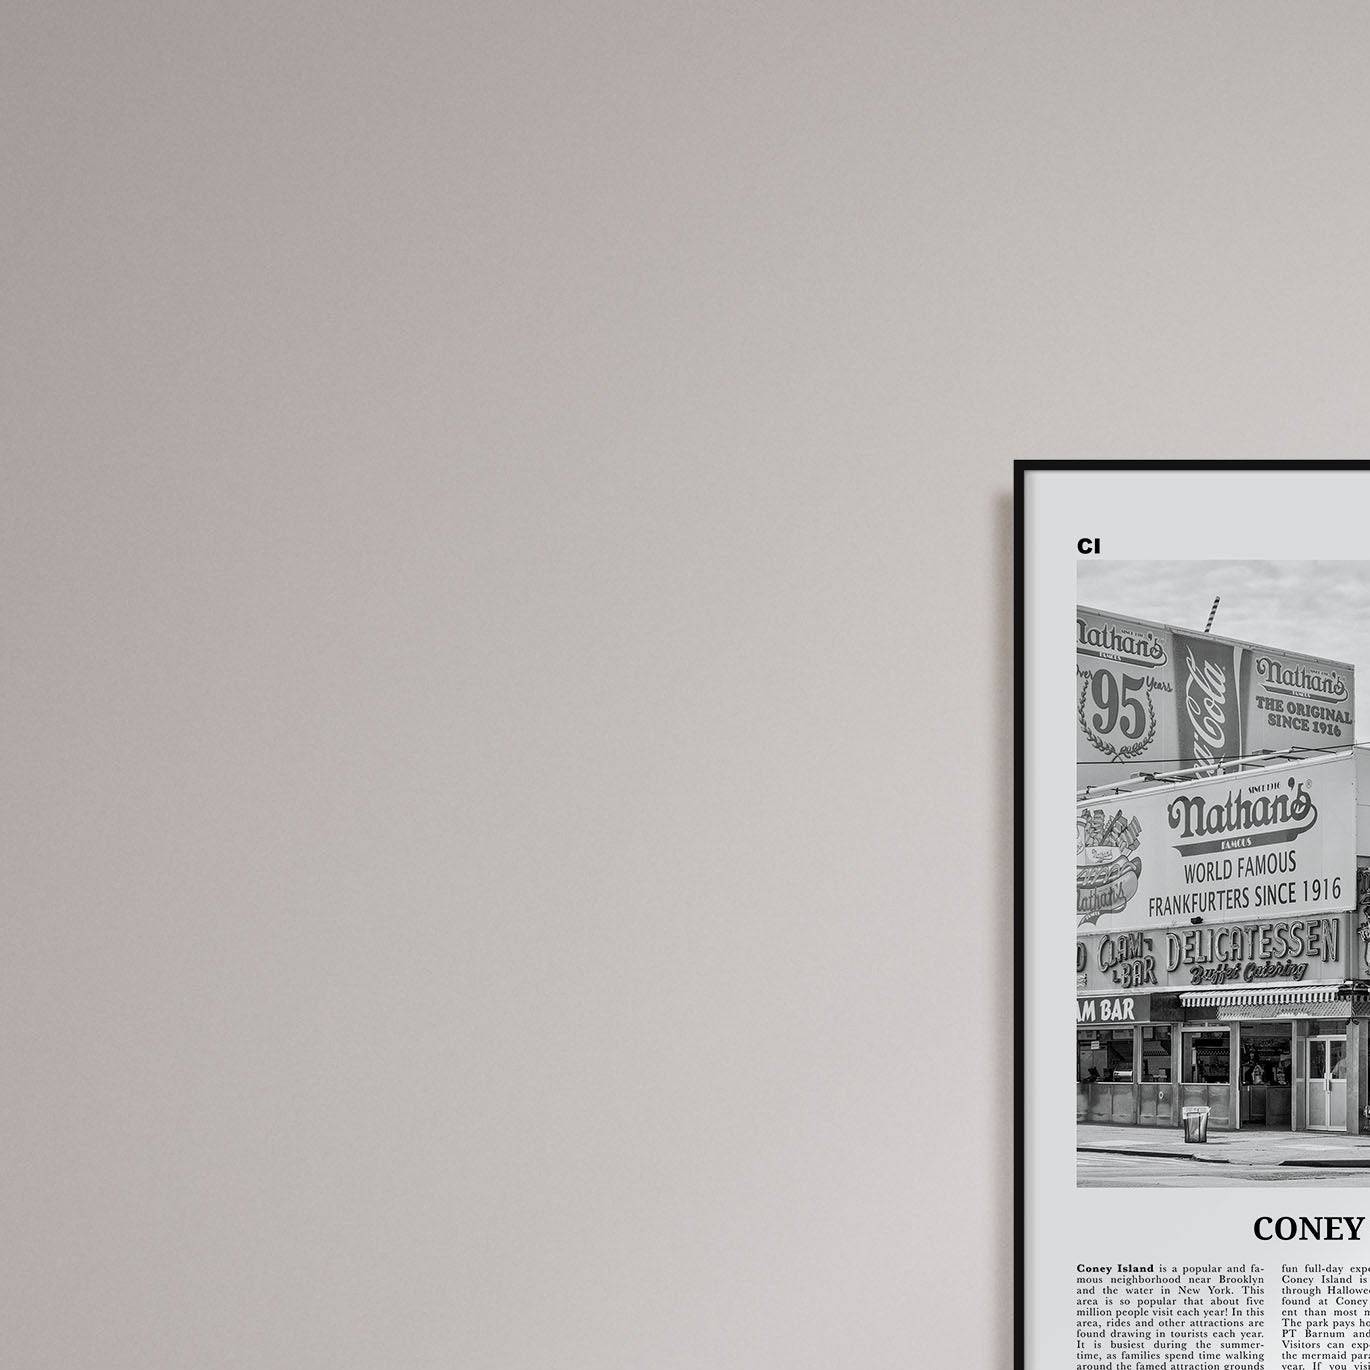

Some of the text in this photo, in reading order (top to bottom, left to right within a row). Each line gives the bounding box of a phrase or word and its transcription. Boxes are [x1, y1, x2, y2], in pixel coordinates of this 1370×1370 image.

[1077, 538, 1100, 554] CI
[1256, 657, 1345, 695] Nathan's
[1092, 669, 1145, 739] 95
[1146, 675, 1173, 692] Years
[1256, 696, 1352, 724] THE ORIGINAL
[1268, 713, 1342, 737] SINCE 1916
[1168, 777, 1313, 838] Nathan's
[1220, 838, 1252, 850] FAMOUS
[1184, 850, 1296, 884] WORLD FAMOUS
[1149, 877, 1342, 918] FRANKFURTERS SINCE 1916
[1097, 932, 1143, 972] CLAM
[1166, 918, 1339, 972] DELICATESSEN
[1121, 955, 1157, 988] BAR
[1190, 959, 1308, 984] Buffet Catering
[1100, 998, 1136, 1021] BAR
[1254, 1216, 1365, 1240] CONEY
[1076, 1264, 1113, 1275] Coney
[1117, 1264, 1154, 1273] Island
[1159, 1264, 1167, 1273] is
[1182, 1264, 1223, 1275] popular
[1226, 1264, 1246, 1273] and
[1250, 1264, 1265, 1273] fa-
[1110, 1275, 1181, 1286] neighborhood
[1219, 1275, 1264, 1286] Brooklyn
[1281, 1264, 1298, 1273] fun
[1304, 1264, 1344, 1275] full-day
[1076, 1286, 1265, 1295] and the water in New York. This
[1281, 1286, 1322, 1297] through
[1076, 1321, 1102, 1330] area,
[1106, 1318, 1131, 1327] rides
[1135, 1318, 1154, 1327] and
[1158, 1318, 1186, 1327] other
[1189, 1318, 1244, 1327] attractions
[1281, 1318, 1302, 1327] The
[1306, 1318, 1329, 1330] park
[1332, 1321, 1356, 1330] pays
[1076, 1362, 1113, 1370] around
[1116, 1362, 1132, 1370] the
[1136, 1362, 1167, 1370] famed
[1170, 1362, 1220, 1370] attraction
[1281, 1351, 1298, 1360] the
[1301, 1351, 1347, 1360] mermaid
